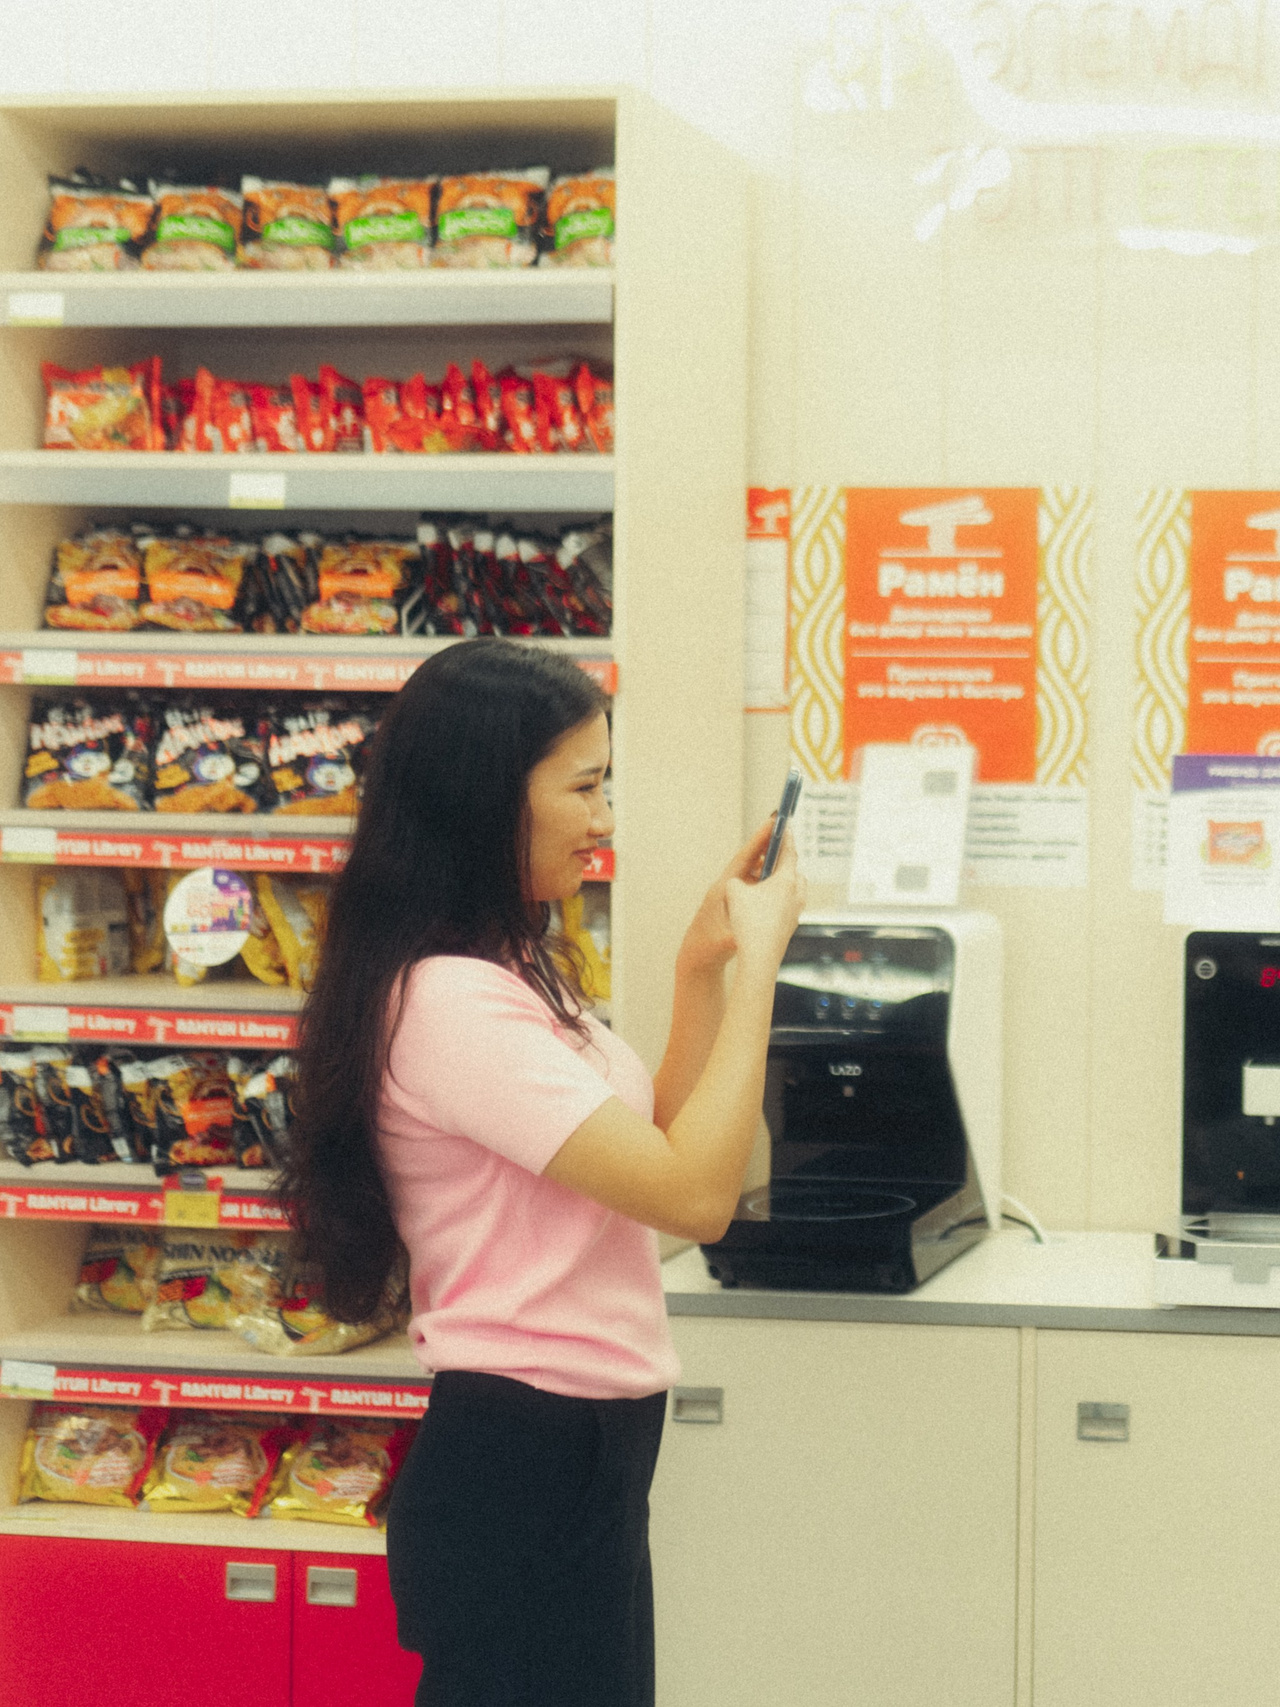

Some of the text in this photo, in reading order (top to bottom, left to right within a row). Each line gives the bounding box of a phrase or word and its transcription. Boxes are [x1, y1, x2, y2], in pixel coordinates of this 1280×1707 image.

[878, 562, 1005, 598] Рамён
[91, 1378, 142, 1397] Library
[244, 1385, 295, 1404] Library
